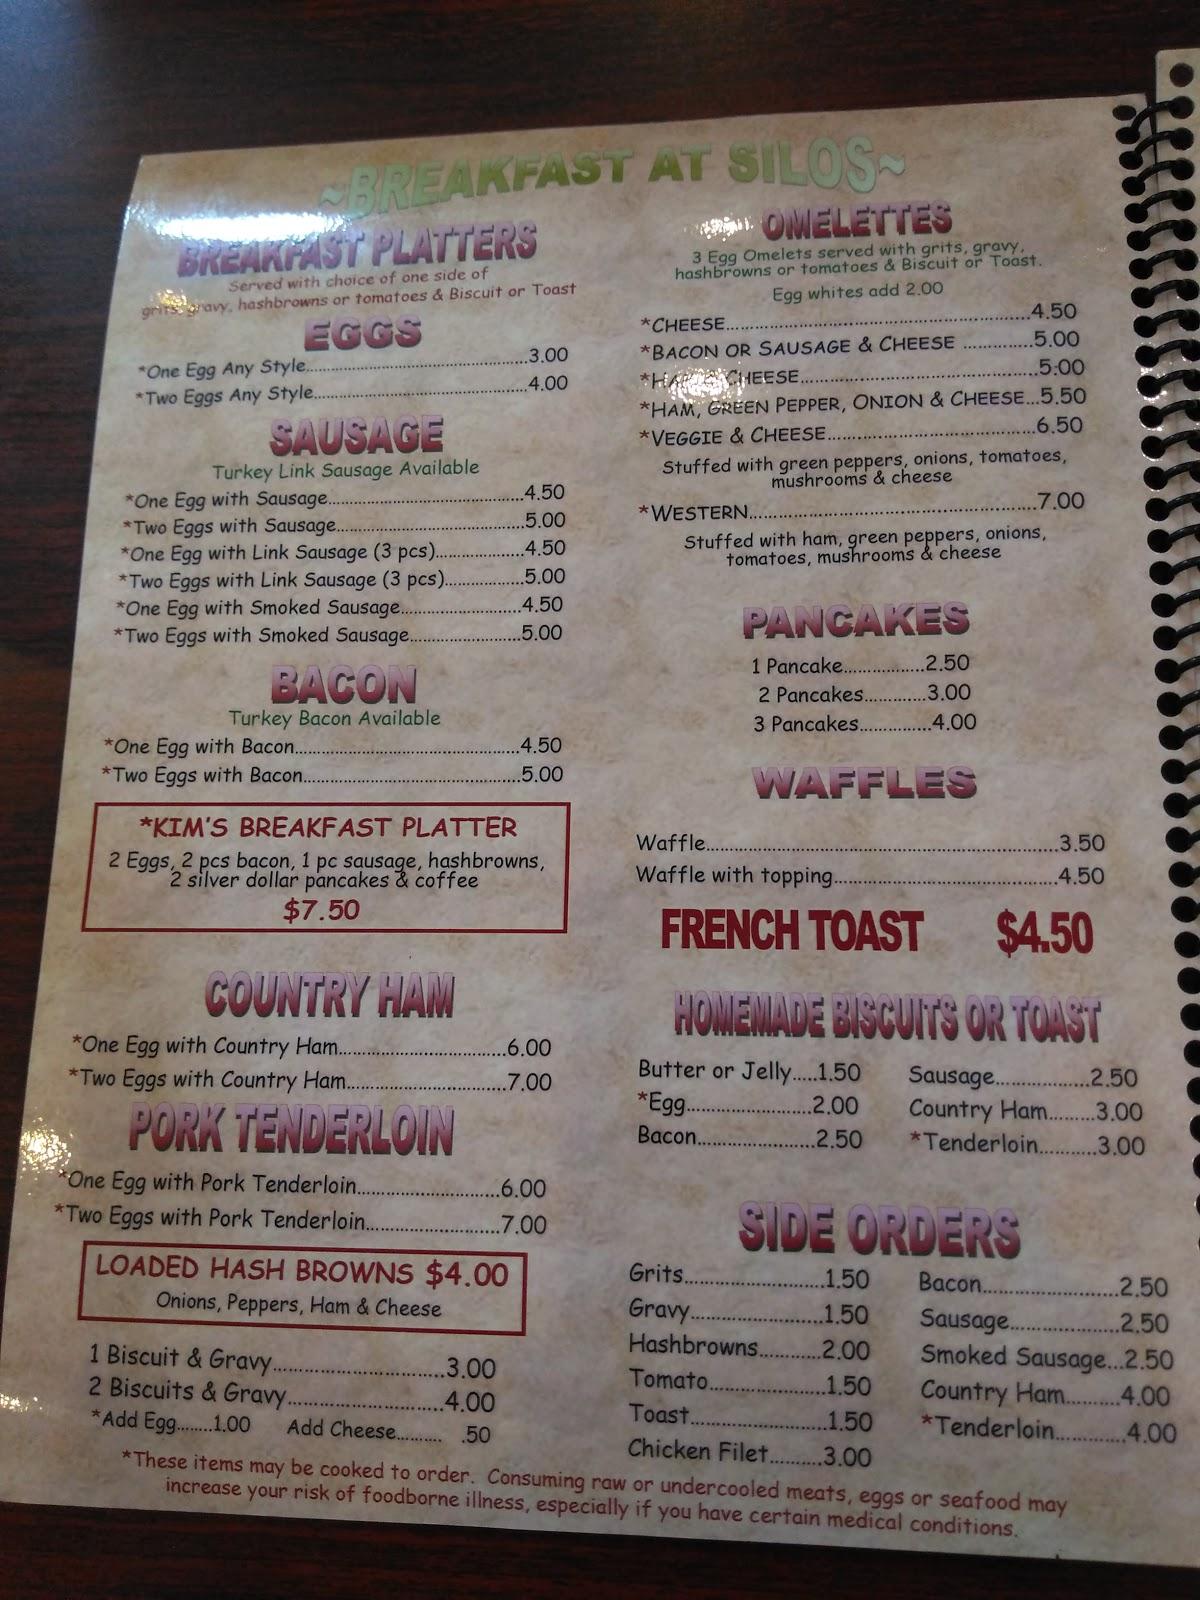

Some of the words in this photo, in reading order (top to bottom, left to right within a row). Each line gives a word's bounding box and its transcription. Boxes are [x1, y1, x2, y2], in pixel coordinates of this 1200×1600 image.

[649, 145, 712, 182] AT
[761, 201, 953, 241] OMELETTES
[177, 229, 365, 277] BREAKFAST
[372, 220, 537, 266] PLATTERS
[692, 251, 702, 264] 3
[708, 250, 737, 267] Egg
[743, 247, 812, 262] Omelets
[818, 243, 874, 259] served
[879, 241, 916, 256] with
[921, 240, 968, 259] grits,
[973, 242, 1024, 257] gravy,
[229, 276, 284, 292] Served
[287, 276, 320, 290] with
[326, 274, 375, 288] choice
[379, 270, 397, 285] of
[401, 273, 429, 283] one
[434, 268, 466, 282] side
[471, 265, 489, 280] of
[675, 265, 771, 280] hashbrowns
[777, 266, 795, 276] or
[801, 261, 878, 275] tomatoes
[884, 258, 896, 272] &
[902, 256, 958, 271] Biscuit
[964, 258, 983, 268] or
[989, 254, 1042, 267] Toast.
[238, 296, 328, 313] hashbrowns
[332, 295, 351, 306] or
[355, 291, 428, 305] tomatoes
[432, 288, 443, 301] &
[449, 286, 503, 301] Biscuit
[508, 287, 526, 297] or
[532, 282, 577, 296] Toast
[773, 287, 803, 305] Egg
[808, 285, 863, 300] whites
[869, 281, 899, 297] add
[905, 280, 944, 296] 2.00
[304, 314, 421, 352] EGGS
[269, 414, 444, 457] SAUSAGE
[212, 464, 273, 483] Turkey
[279, 462, 315, 479] Link
[321, 463, 393, 481] Sausage
[399, 458, 479, 476] Available
[662, 457, 731, 475] Stuffed
[737, 456, 773, 472] with
[779, 458, 828, 475] green
[834, 455, 910, 473] peppers,
[914, 451, 973, 466] onions,
[979, 449, 1067, 464] tomatoes,
[772, 472, 867, 489] mushrooms
[873, 469, 885, 485] &
[891, 468, 953, 485] cheese
[684, 532, 753, 550] Stuffed
[760, 531, 796, 547] with
[803, 530, 842, 547] ham,
[848, 532, 898, 549] green
[904, 529, 979, 548] peppers,
[986, 525, 1046, 542] onions,
[726, 552, 811, 567] tomatoes,
[818, 548, 915, 564] mushrooms
[921, 546, 933, 561] &
[939, 544, 1001, 560] cheese
[742, 601, 970, 640] PANCAKES
[271, 664, 417, 703] BACON
[228, 709, 292, 731] Turkey
[299, 709, 351, 726] Bacon
[358, 709, 441, 726] Available
[754, 765, 977, 799] WAFFLES
[240, 816, 393, 838] BREAKFAST
[402, 816, 517, 838] PLATTER
[109, 851, 120, 868] 2
[127, 851, 176, 872] Eggs,
[181, 852, 193, 868] 2
[199, 856, 230, 871] pcs
[237, 851, 295, 871] bacon,
[302, 852, 309, 868] 1
[316, 856, 337, 874] pc
[343, 856, 422, 872] sausage,
[428, 851, 544, 872] hashbrowns,
[170, 871, 182, 887] 2
[187, 870, 240, 888] silver
[246, 870, 299, 888] dollar
[305, 871, 389, 893] pancakes
[394, 872, 408, 888] &
[415, 870, 479, 889] coffee
[283, 897, 360, 924] $7.50
[661, 908, 799, 950] FRENCH
[809, 910, 924, 952] TOAST
[997, 907, 1094, 959] $4.50
[204, 971, 369, 1018] COUNTRY
[379, 972, 455, 1018] HAM
[674, 990, 825, 1039] HOMEMADE
[833, 993, 959, 1040] BISCUITS
[966, 996, 1006, 1042] OR
[1012, 995, 1102, 1043] TOAST
[129, 1102, 227, 1153] PORK
[234, 1103, 455, 1155] TENDERLOIN
[739, 1201, 834, 1252] SIDE
[847, 1203, 1021, 1258] ORDERS
[96, 1253, 199, 1279] LOADED
[210, 1256, 285, 1280] HASH
[296, 1259, 414, 1285] BROWNS
[426, 1258, 509, 1290] $4.00
[156, 1291, 221, 1313] Onions,
[227, 1293, 303, 1317] Peppers,
[310, 1296, 350, 1315] Ham
[357, 1297, 369, 1315] &
[375, 1297, 442, 1317] Cheese
[90, 1343, 98, 1363] 1
[107, 1344, 179, 1367] Biscuit
[187, 1347, 202, 1369] &
[447, 1357, 496, 1380] 3.00
[921, 1344, 1007, 1366] Smoked
[1125, 1348, 1174, 1371] 2.50
[628, 1437, 711, 1460] Chicken
[823, 1446, 872, 1468] 3.00
[194, 1454, 243, 1472] items
[250, 1461, 285, 1479] may
[291, 1457, 314, 1476] be
[320, 1460, 384, 1479] cooked
[390, 1464, 410, 1480] to
[417, 1465, 474, 1484] order.
[487, 1468, 585, 1494] Consuming
[592, 1477, 626, 1491] raw
[633, 1480, 654, 1492] or
[661, 1476, 779, 1499] undercooked
[786, 1485, 852, 1506] meats,
[859, 1490, 904, 1510] eggs
[911, 1493, 933, 1507] or
[939, 1490, 1021, 1512] seafood
[1028, 1498, 1068, 1518] may
[166, 1476, 242, 1496] increase
[247, 1485, 288, 1502] your
[294, 1483, 330, 1501] risk
[335, 1484, 356, 1502] of
[362, 1485, 460, 1507] foodborne
[466, 1490, 530, 1514] illness,
[536, 1497, 629, 1520] especially
[636, 1499, 652, 1518] if
[657, 1506, 691, 1523] you
[698, 1502, 743, 1522] have
[749, 1508, 820, 1525] certain
[827, 1510, 902, 1531] medical
[910, 1515, 1018, 1538] conditions.
